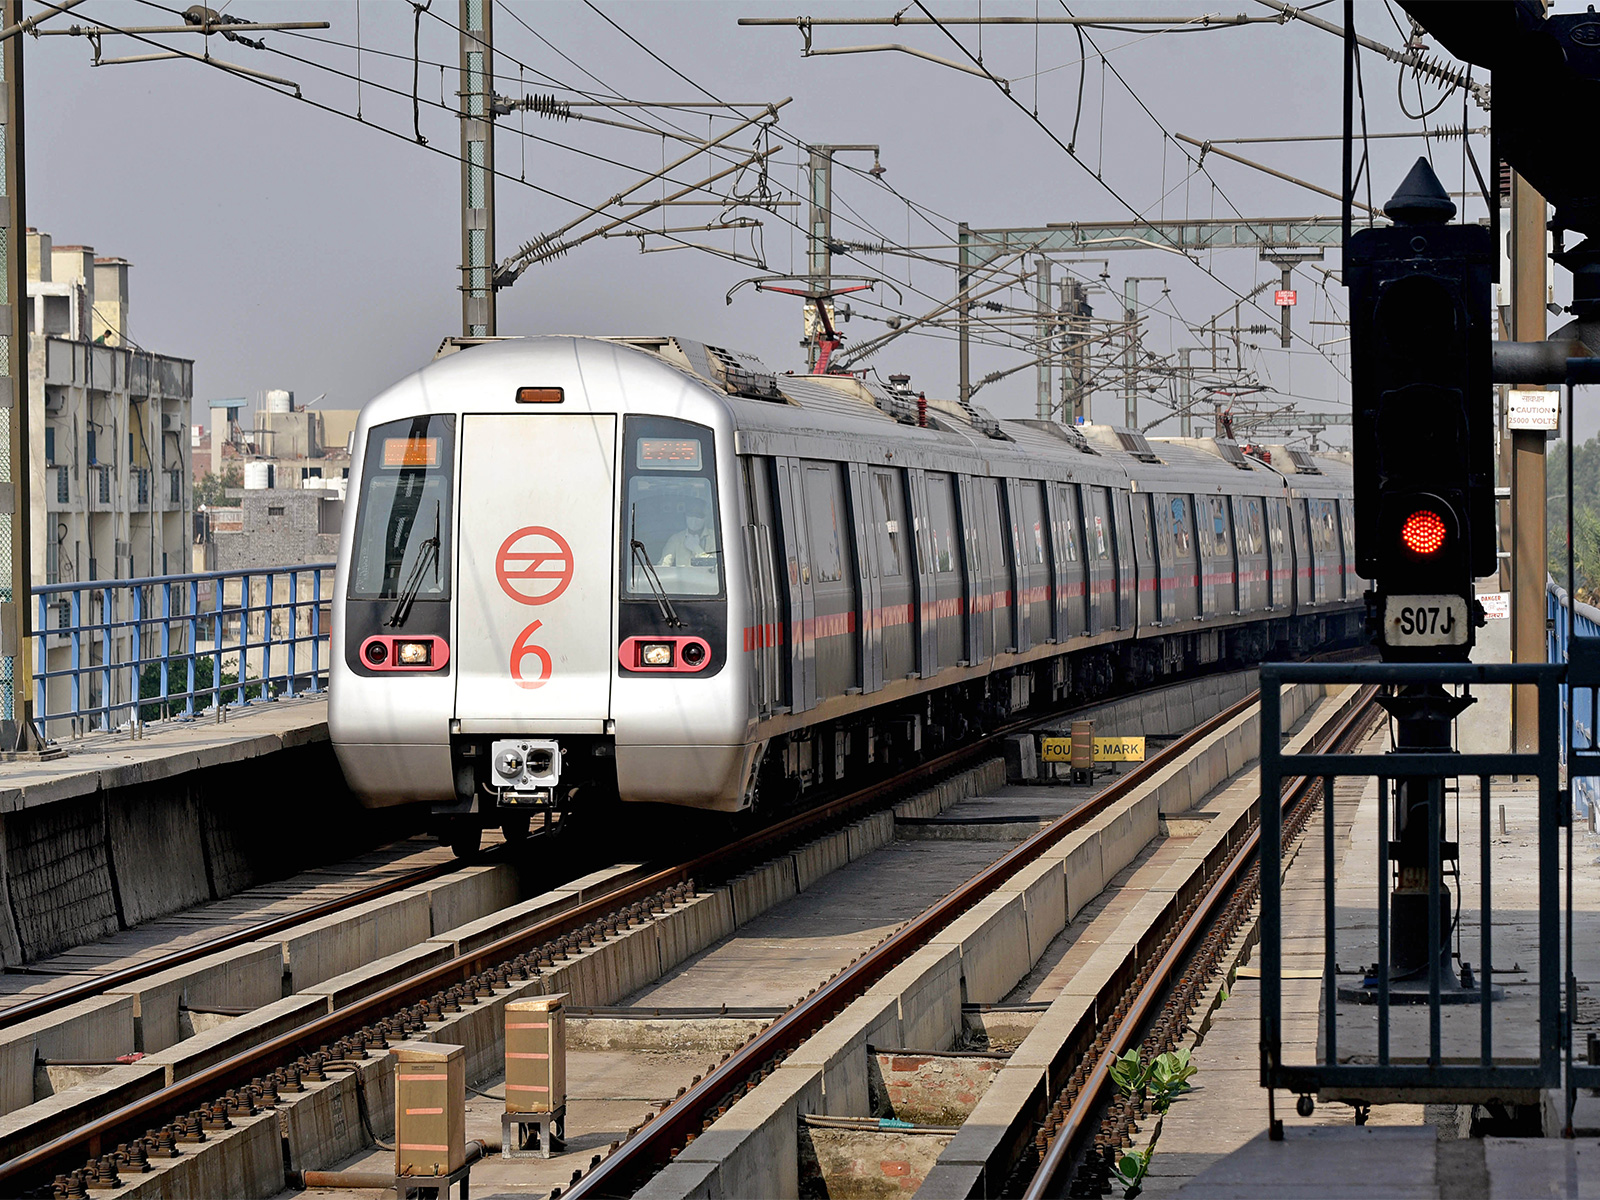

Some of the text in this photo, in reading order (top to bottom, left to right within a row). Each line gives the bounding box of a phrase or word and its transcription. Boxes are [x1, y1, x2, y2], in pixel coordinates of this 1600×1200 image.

[1508, 416, 1557, 425] 25000 VOLTS
[1400, 606, 1453, 635] S07J
[509, 618, 553, 690] 6
[1103, 743, 1139, 755] MARK
